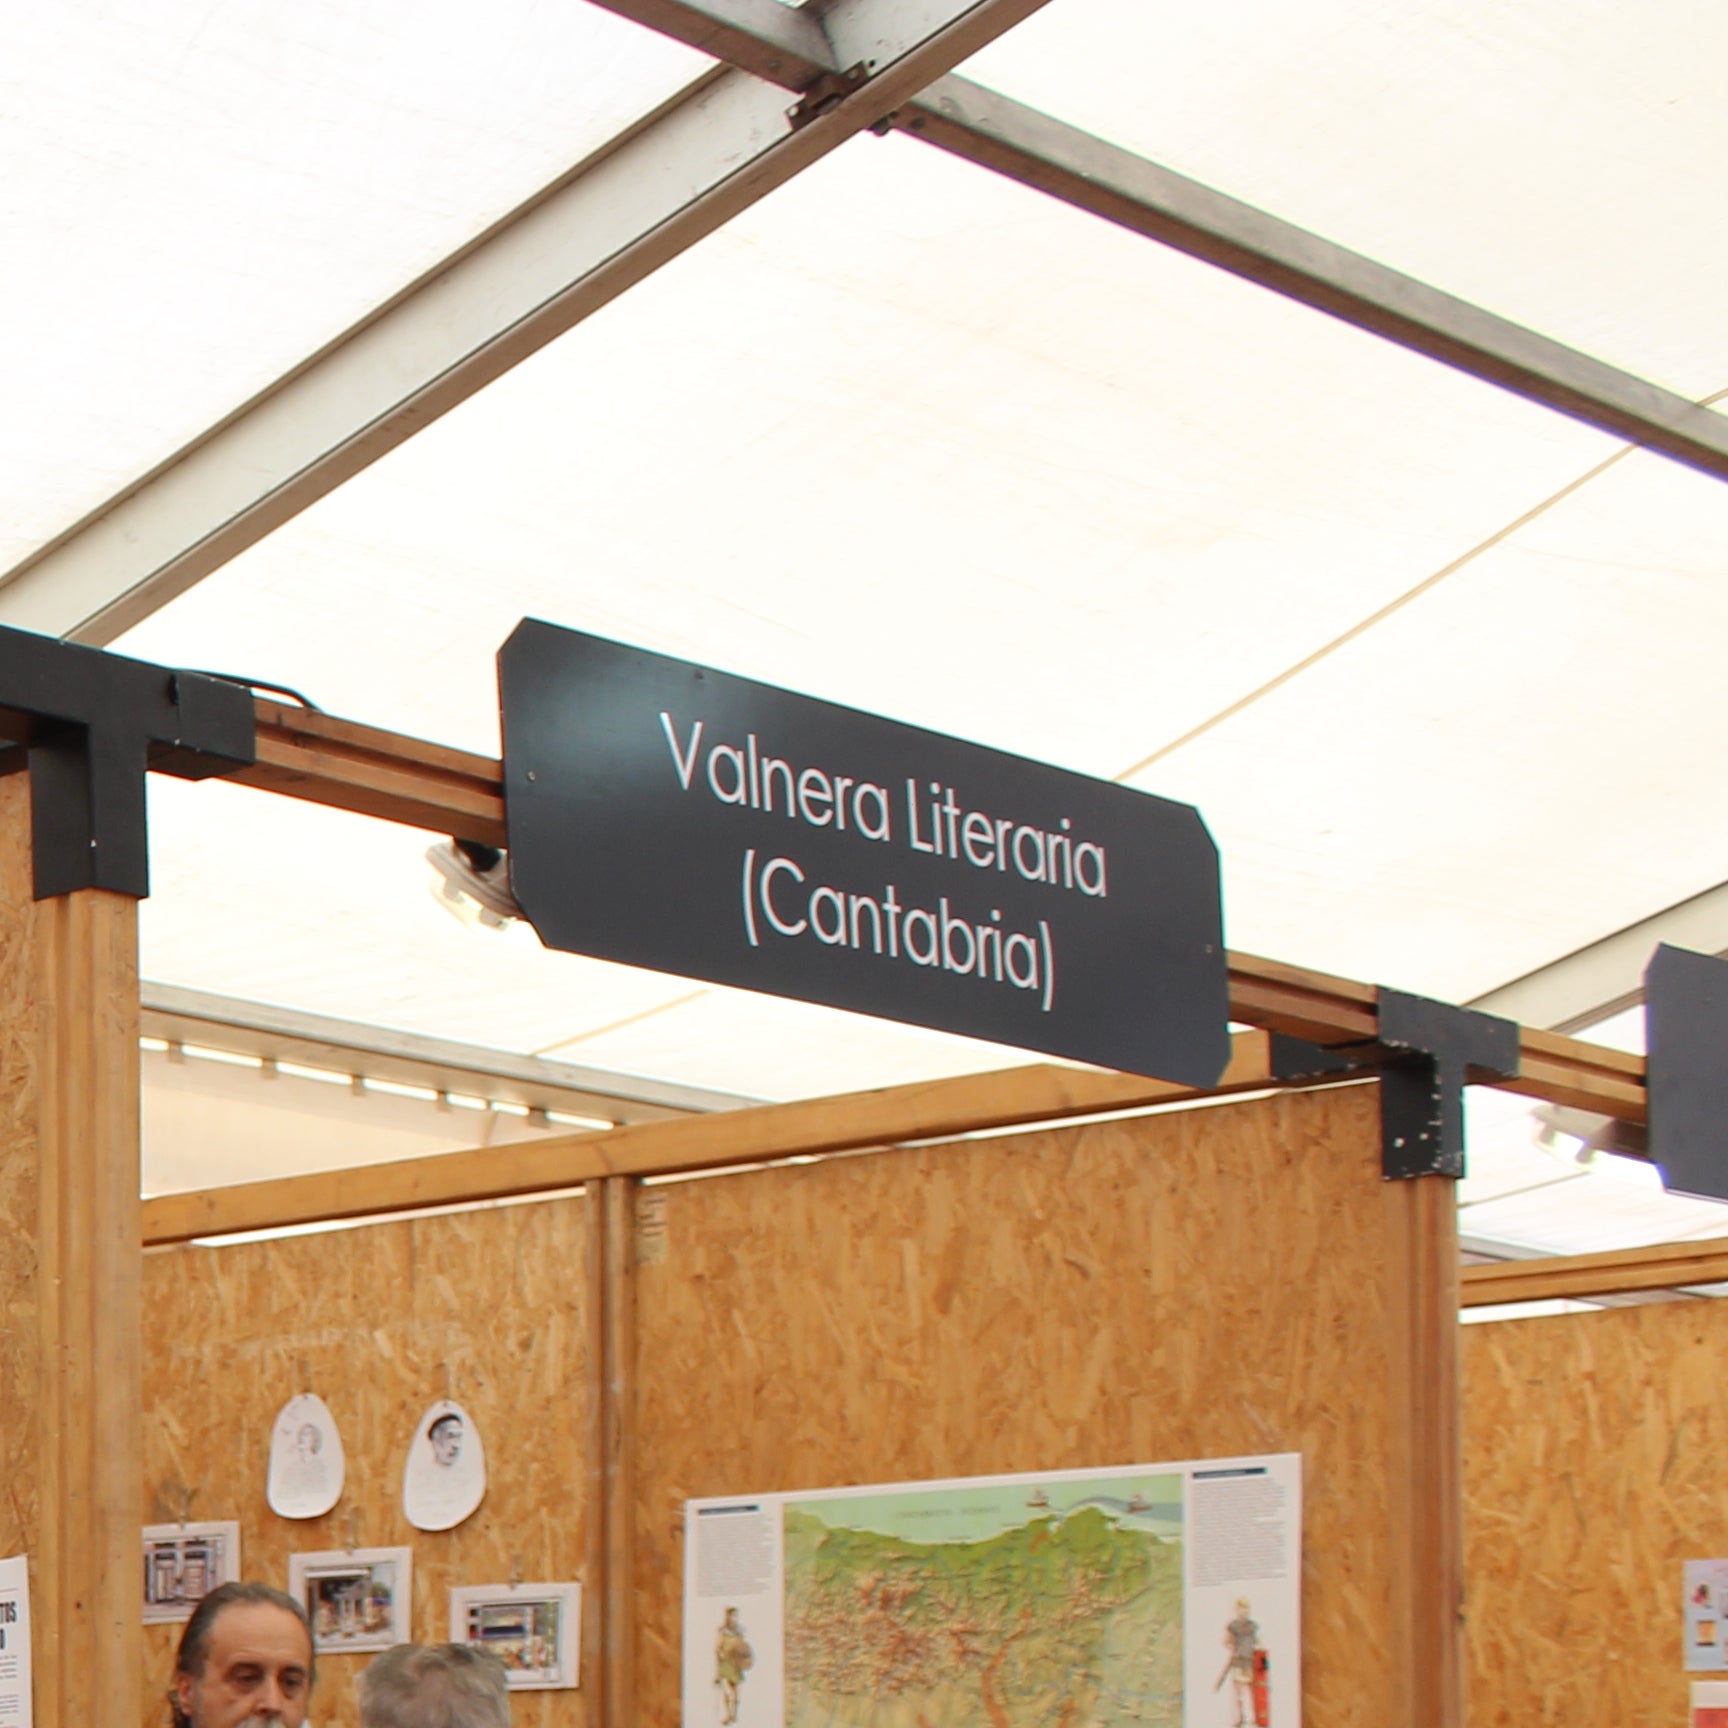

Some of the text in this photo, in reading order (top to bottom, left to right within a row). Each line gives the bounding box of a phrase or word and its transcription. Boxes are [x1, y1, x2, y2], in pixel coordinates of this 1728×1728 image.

[658, 710, 1107, 898] Valnera Literaria
[743, 847, 1056, 1012] (Cantabria)
